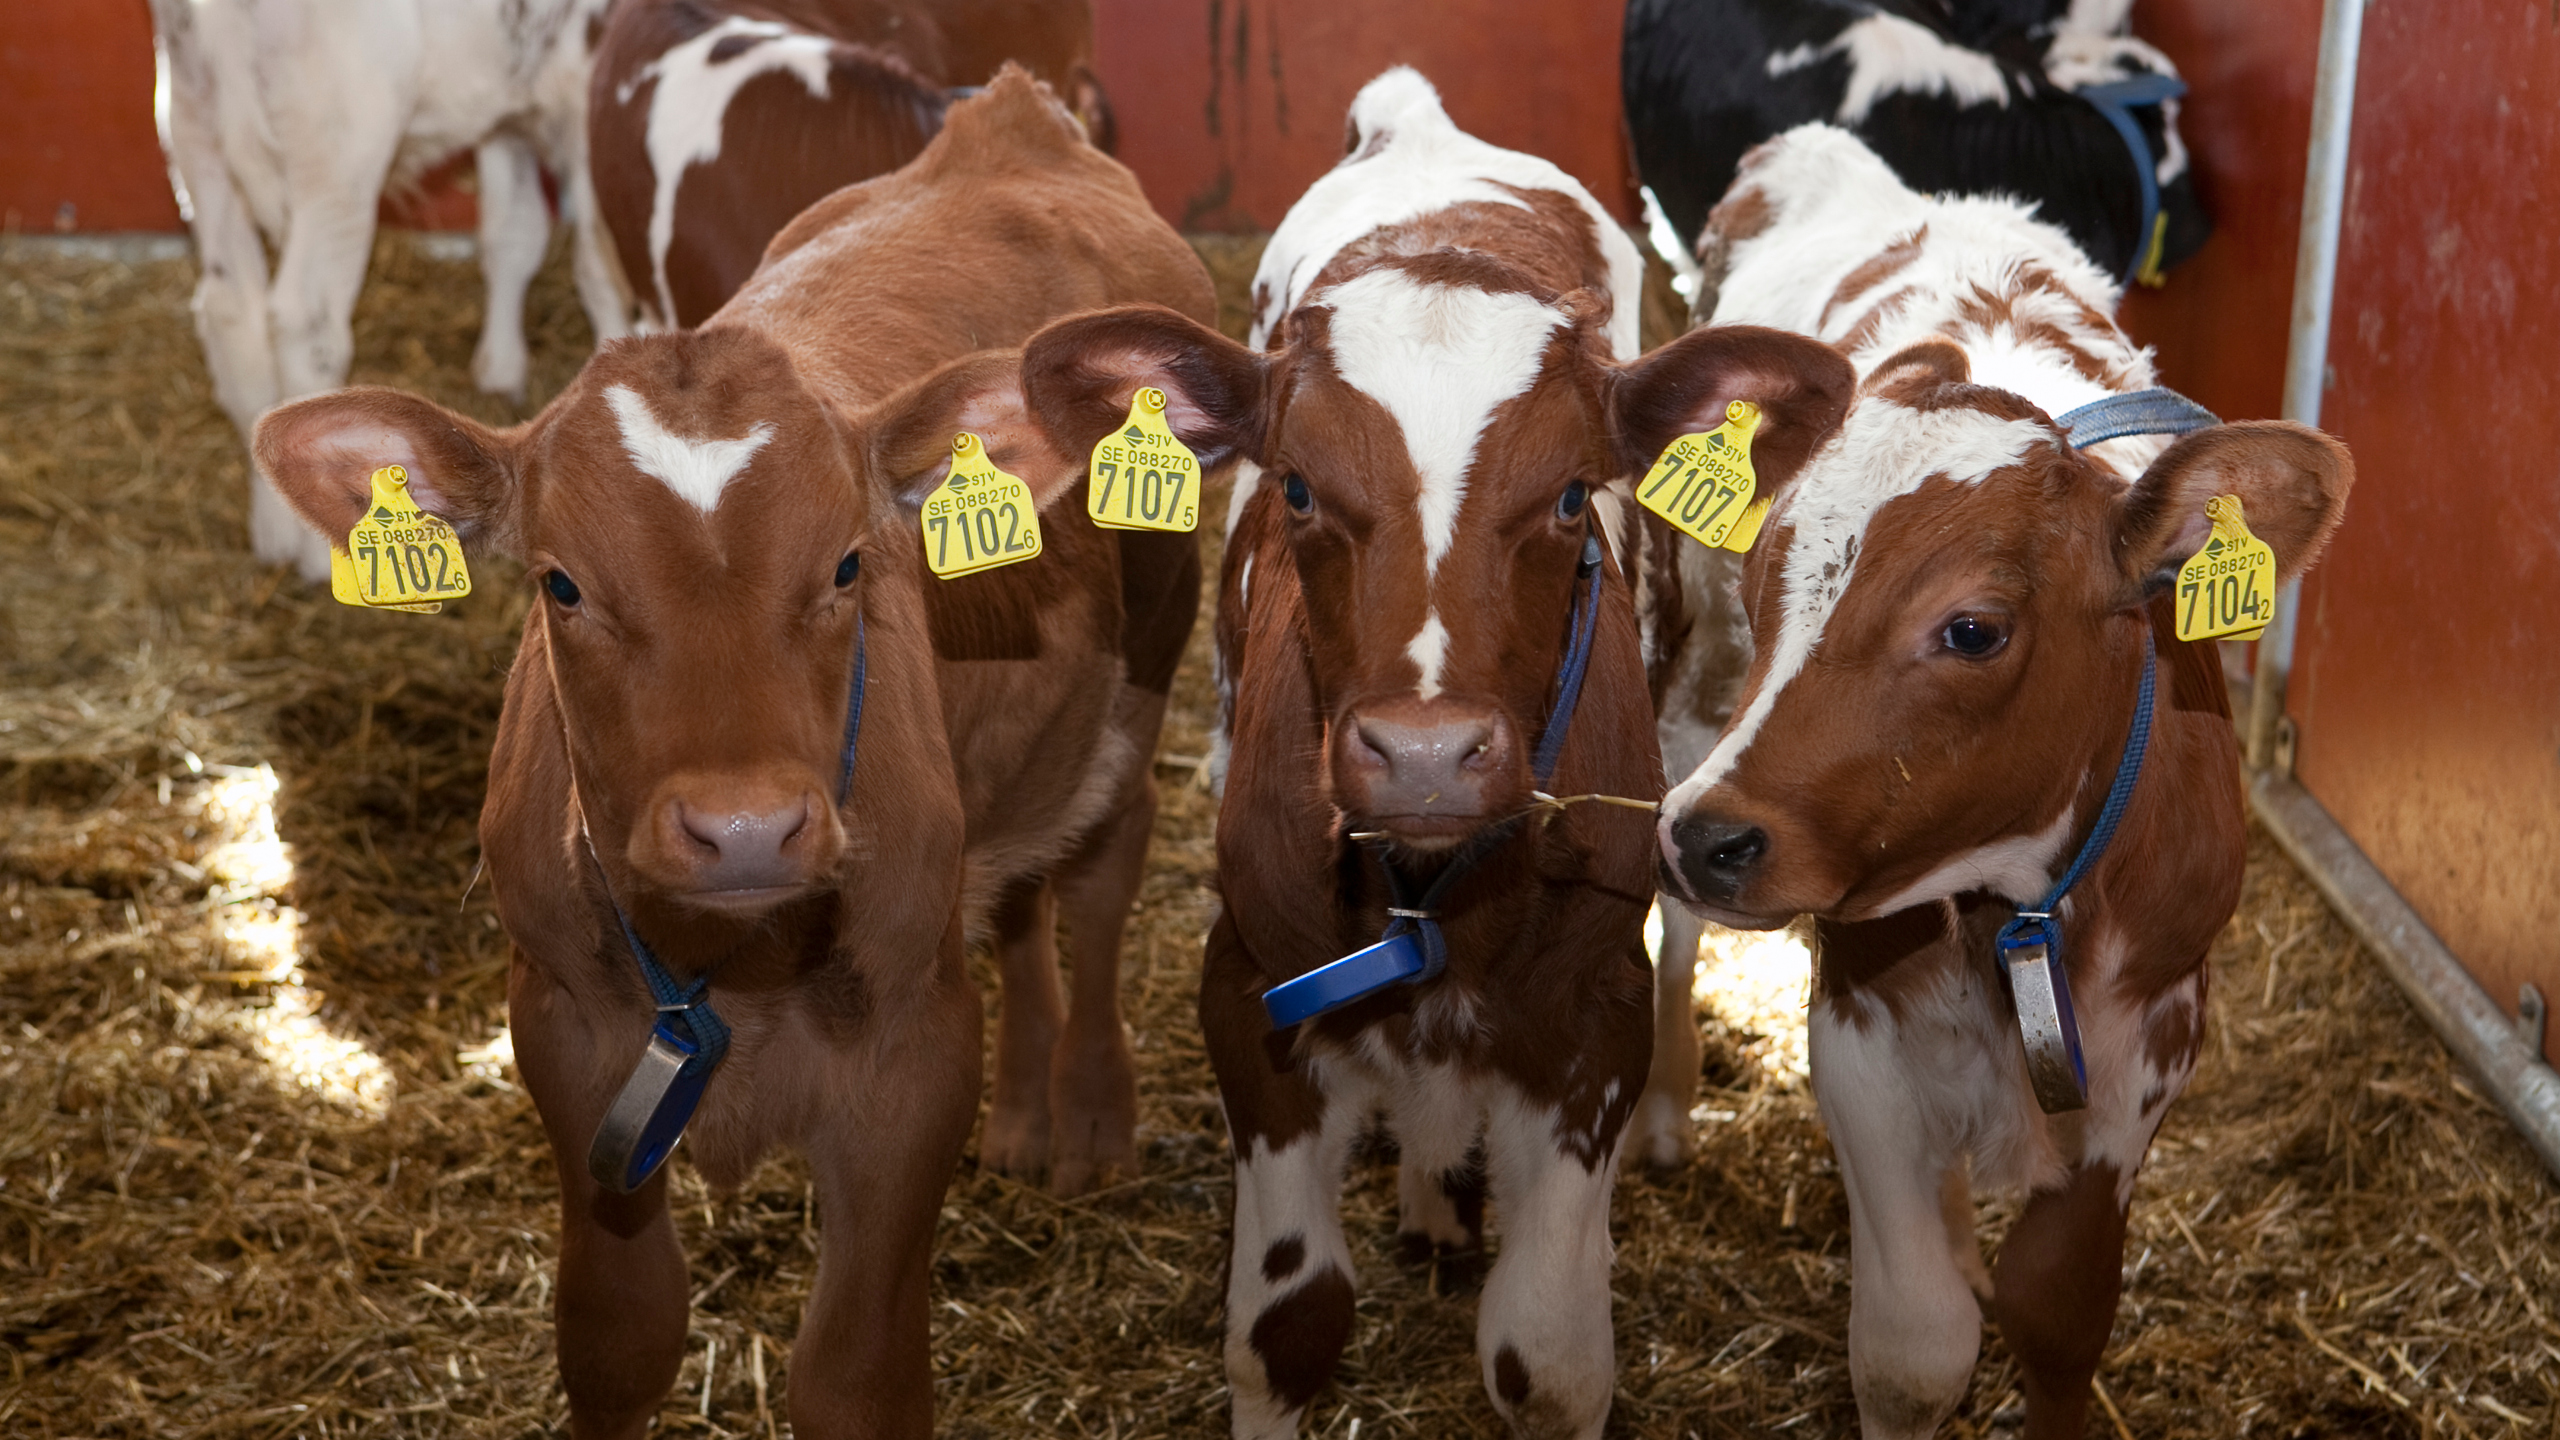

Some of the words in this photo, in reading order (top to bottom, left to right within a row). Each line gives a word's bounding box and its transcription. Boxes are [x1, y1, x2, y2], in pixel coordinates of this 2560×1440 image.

[1147, 433, 1172, 448] SJV
[1723, 445, 1747, 463] SJV
[1101, 445, 1124, 463] SE
[1128, 450, 1192, 471] 088270
[1676, 441, 1700, 461] SE
[1697, 453, 1750, 492] 088270
[971, 471, 996, 486] SJV
[1097, 461, 1186, 523] 7107
[1644, 453, 1738, 533] 7107
[928, 499, 952, 516] SE
[955, 484, 1020, 510] 088270
[357, 530, 380, 545] SE
[383, 527, 447, 543] 088270
[928, 502, 1024, 567] 7102
[2226, 536, 2248, 553] SJV
[358, 542, 456, 596] 7102
[2184, 565, 2206, 582] SE
[2209, 551, 2266, 577] 088270
[2181, 569, 2260, 636] 7104
